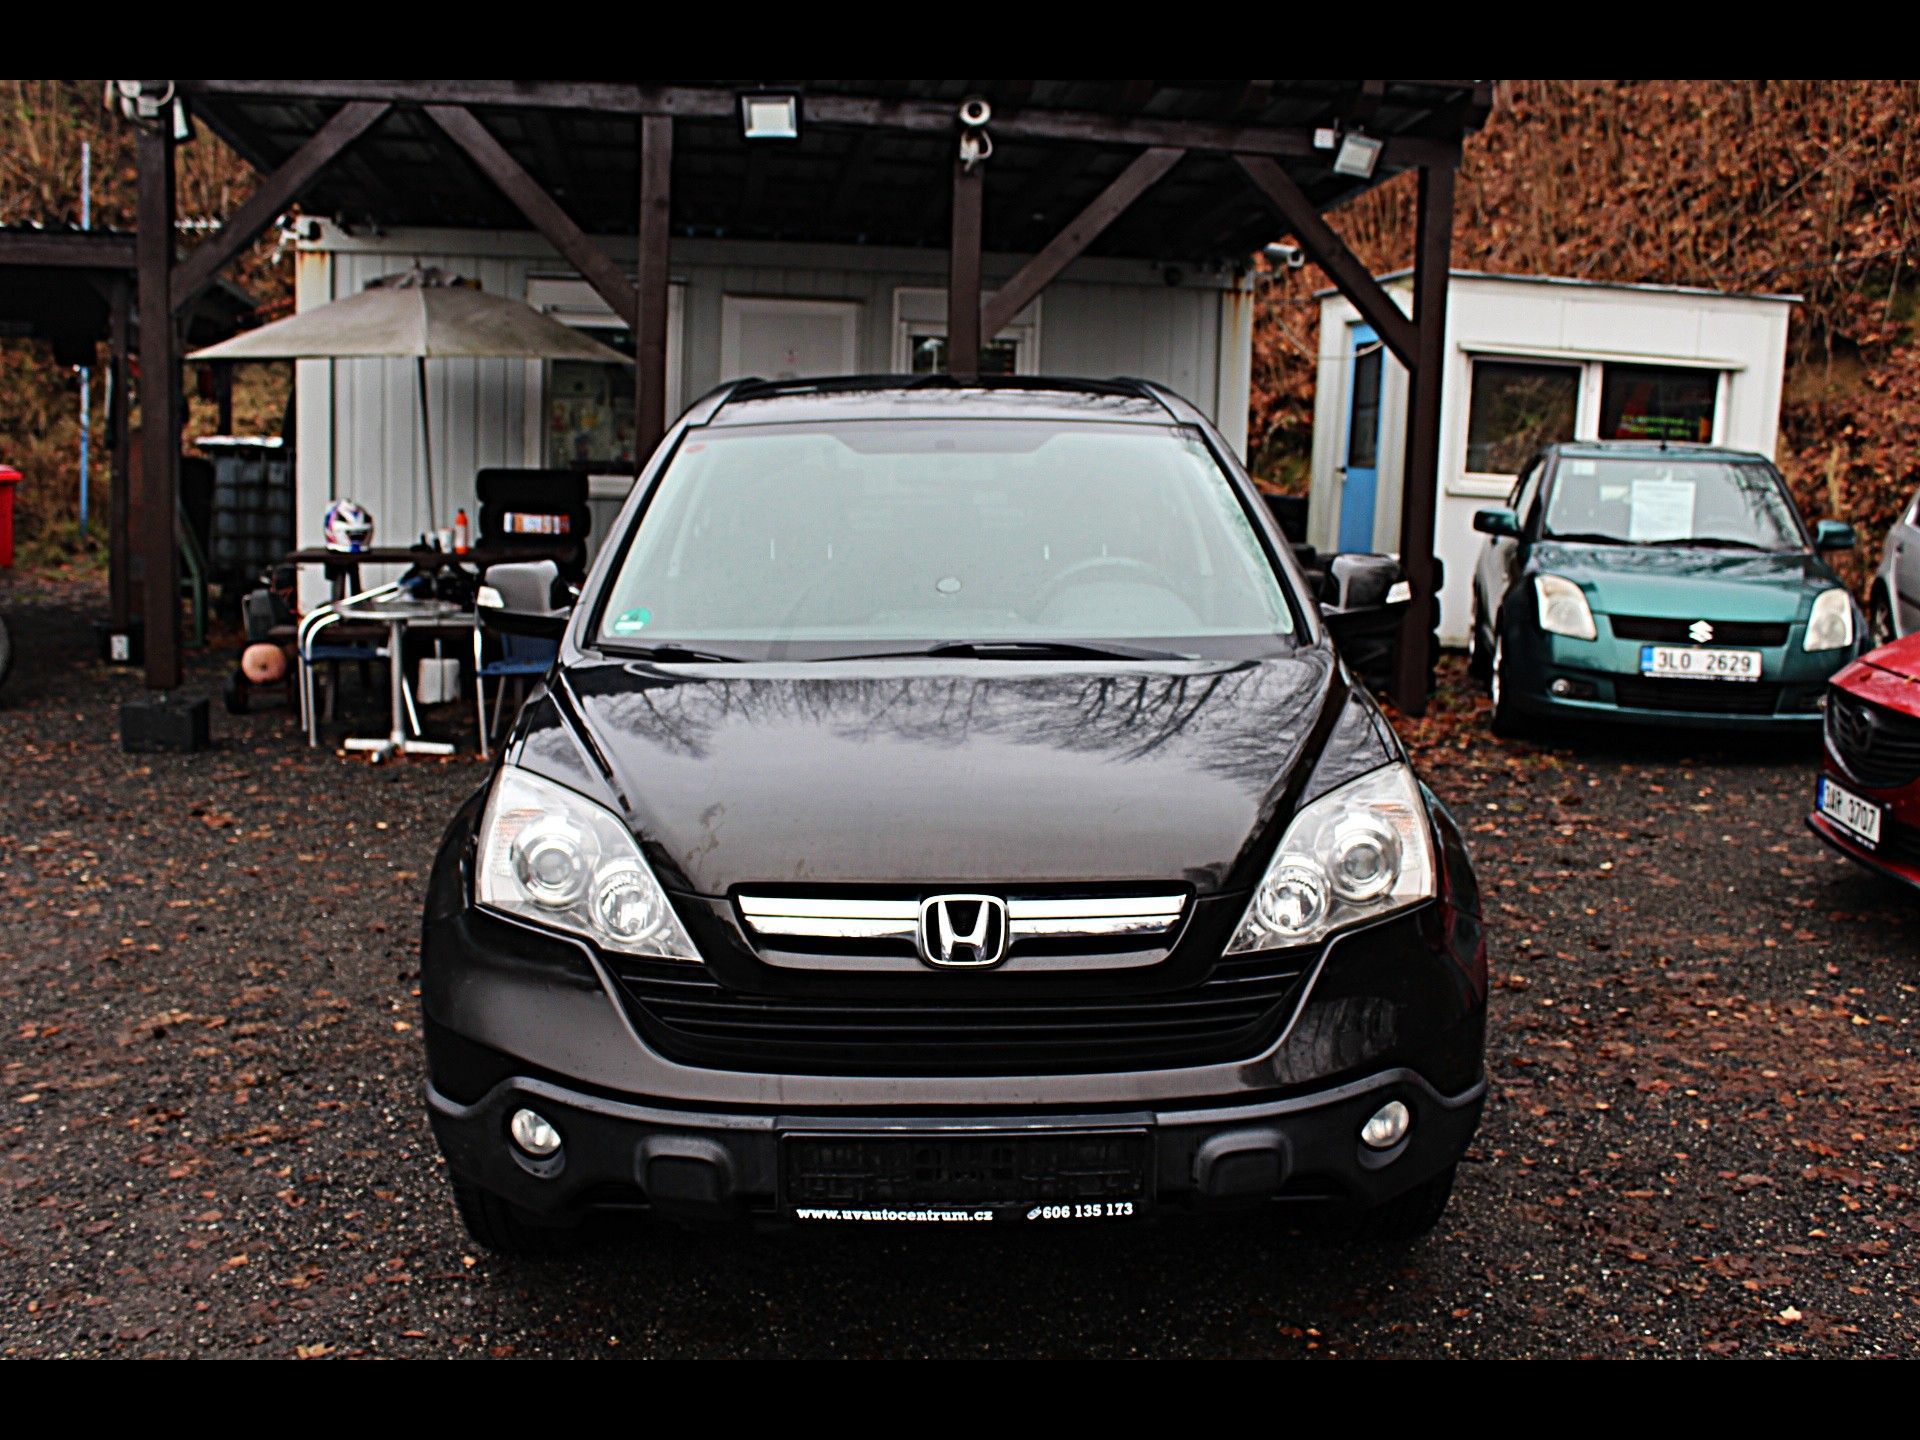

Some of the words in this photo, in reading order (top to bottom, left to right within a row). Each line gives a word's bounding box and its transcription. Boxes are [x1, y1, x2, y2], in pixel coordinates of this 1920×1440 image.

[795, 1207, 994, 1222] www.uvautocentrum.cz
[1042, 1205, 1071, 1220] 606
[1074, 1203, 1102, 1218] 135
[1105, 1201, 1134, 1216] 173
